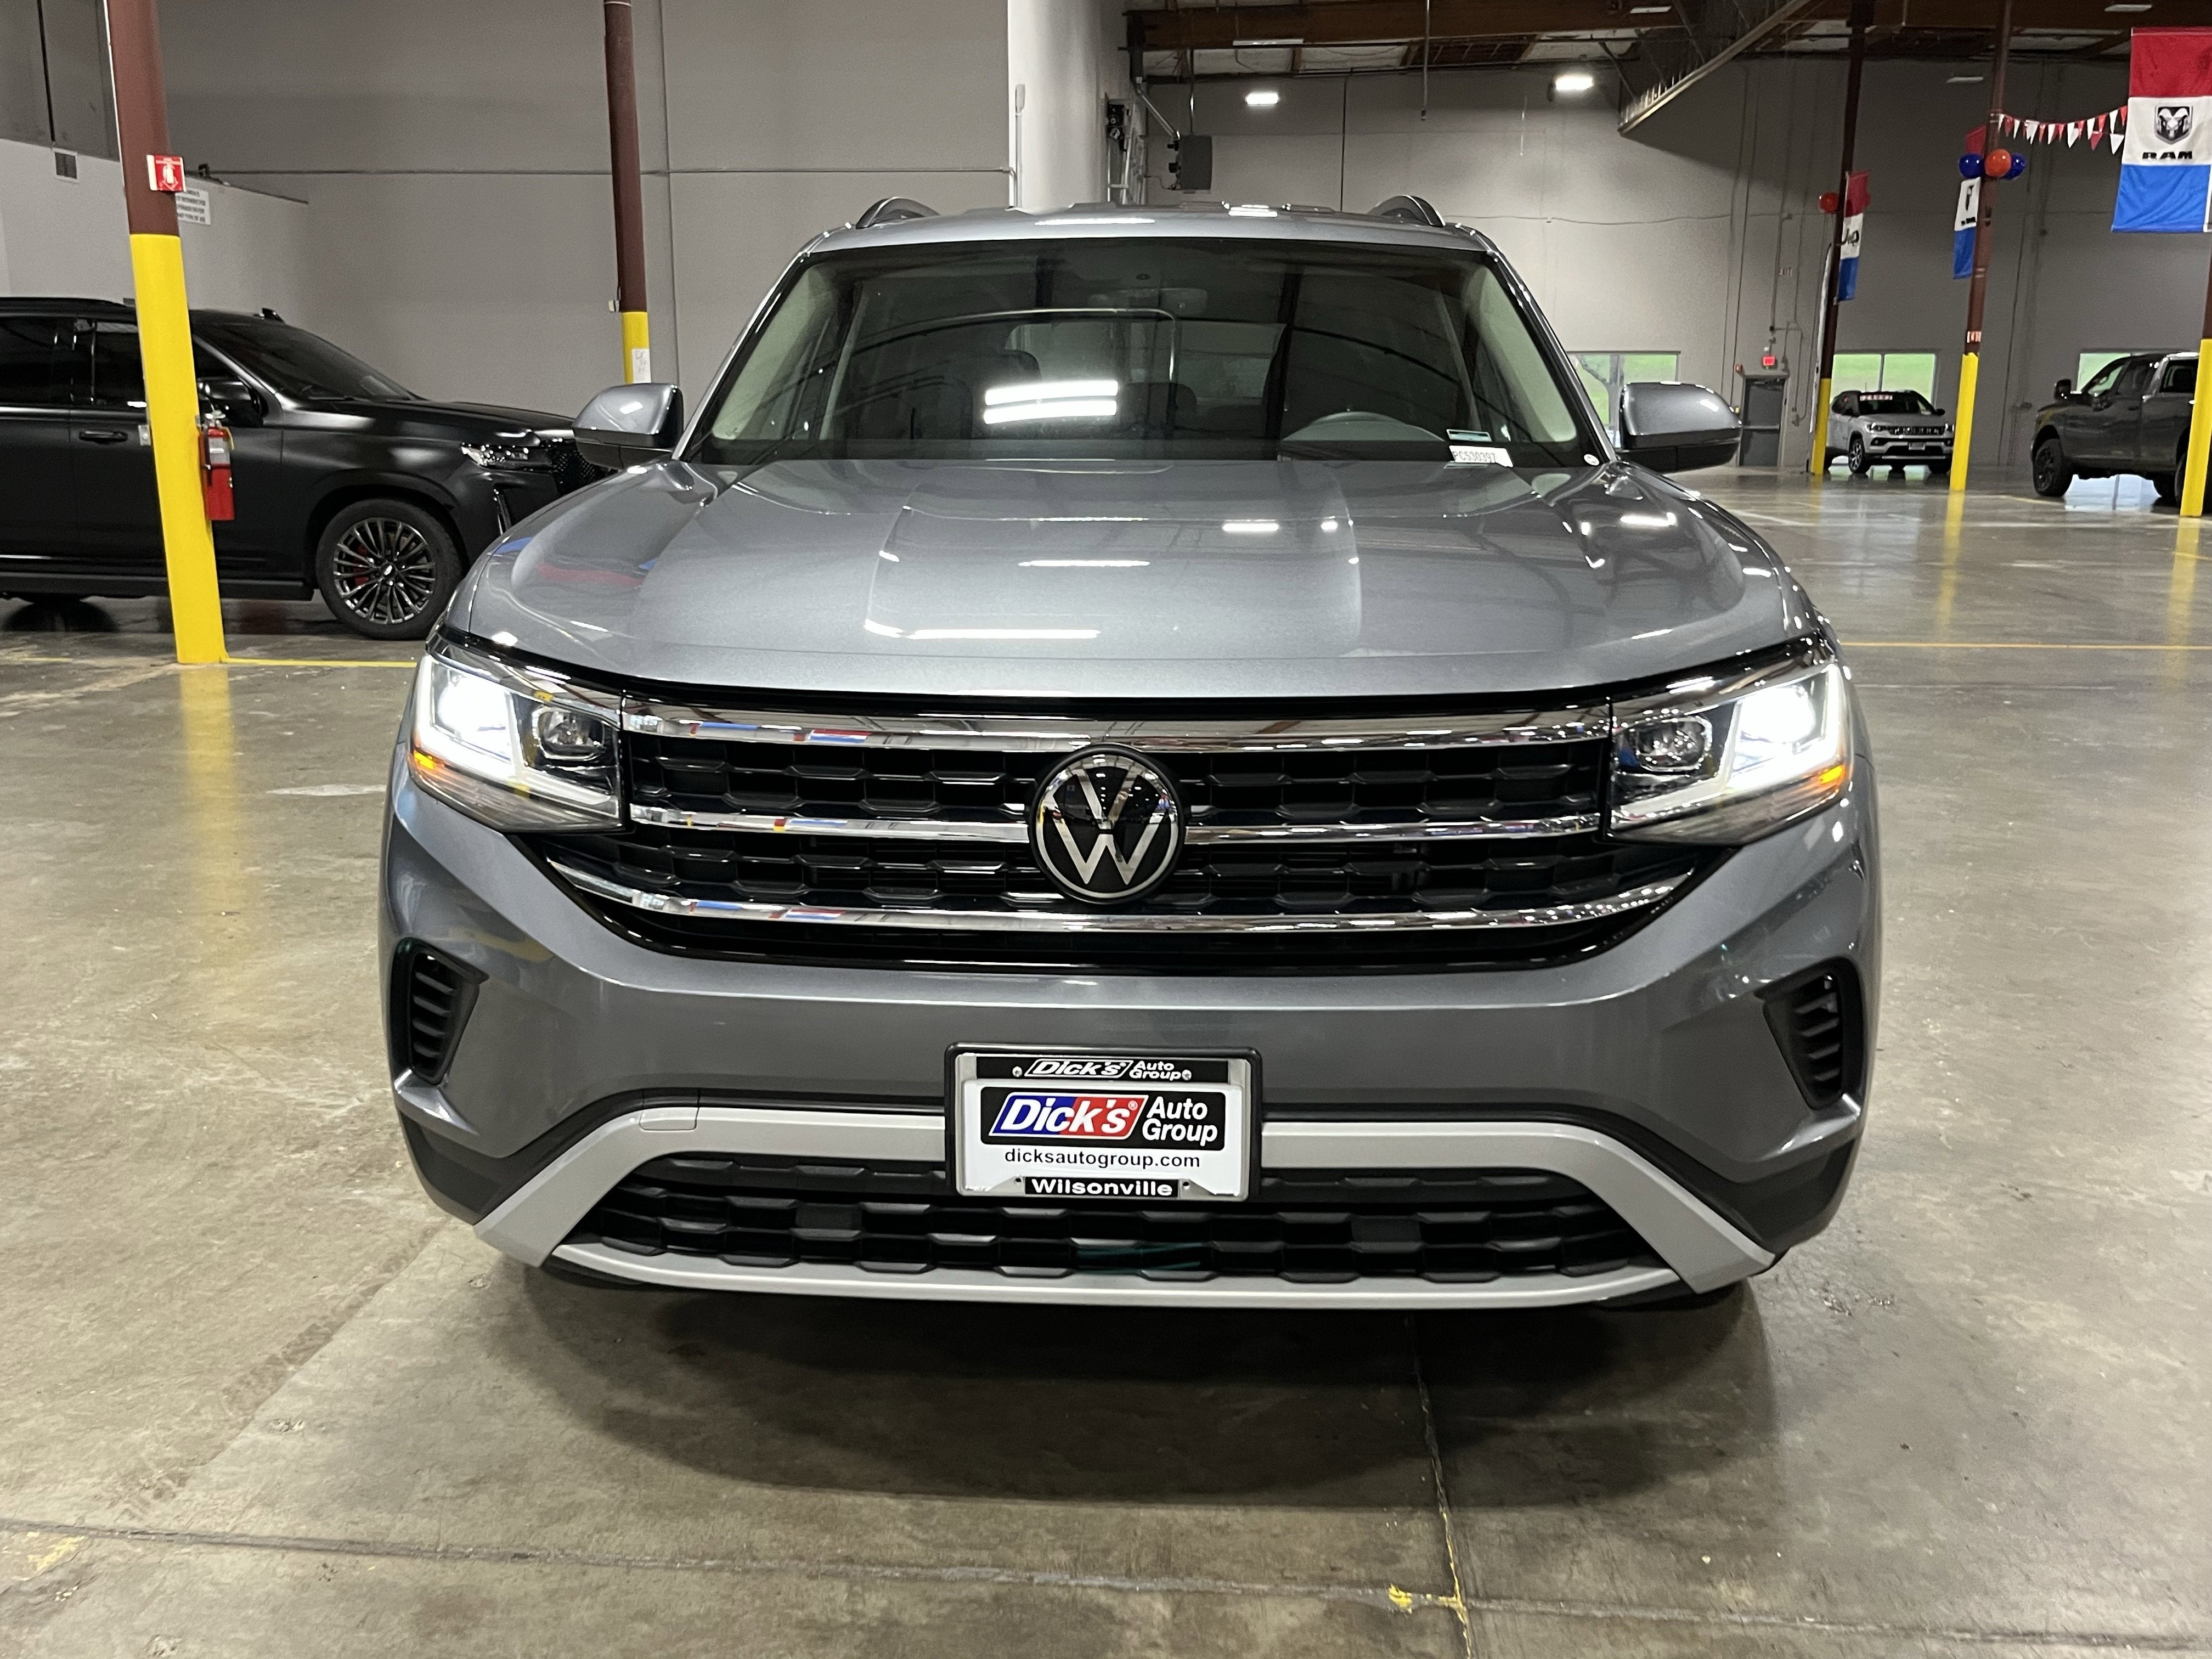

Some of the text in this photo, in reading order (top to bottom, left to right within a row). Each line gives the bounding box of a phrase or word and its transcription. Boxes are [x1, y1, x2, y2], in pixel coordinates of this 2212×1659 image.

[2142, 150, 2192, 160] RAM
[1032, 1060, 1121, 1075] Dick's
[1129, 1069, 1182, 1081] Group
[1133, 1060, 1175, 1071] Auto
[1000, 1097, 1131, 1134] Dick's
[1147, 1096, 1208, 1120] Auto
[1142, 1118, 1218, 1147] Group
[1005, 1148, 1200, 1170] dicksautogroup.com
[1031, 1178, 1173, 1197] Wilsonville
